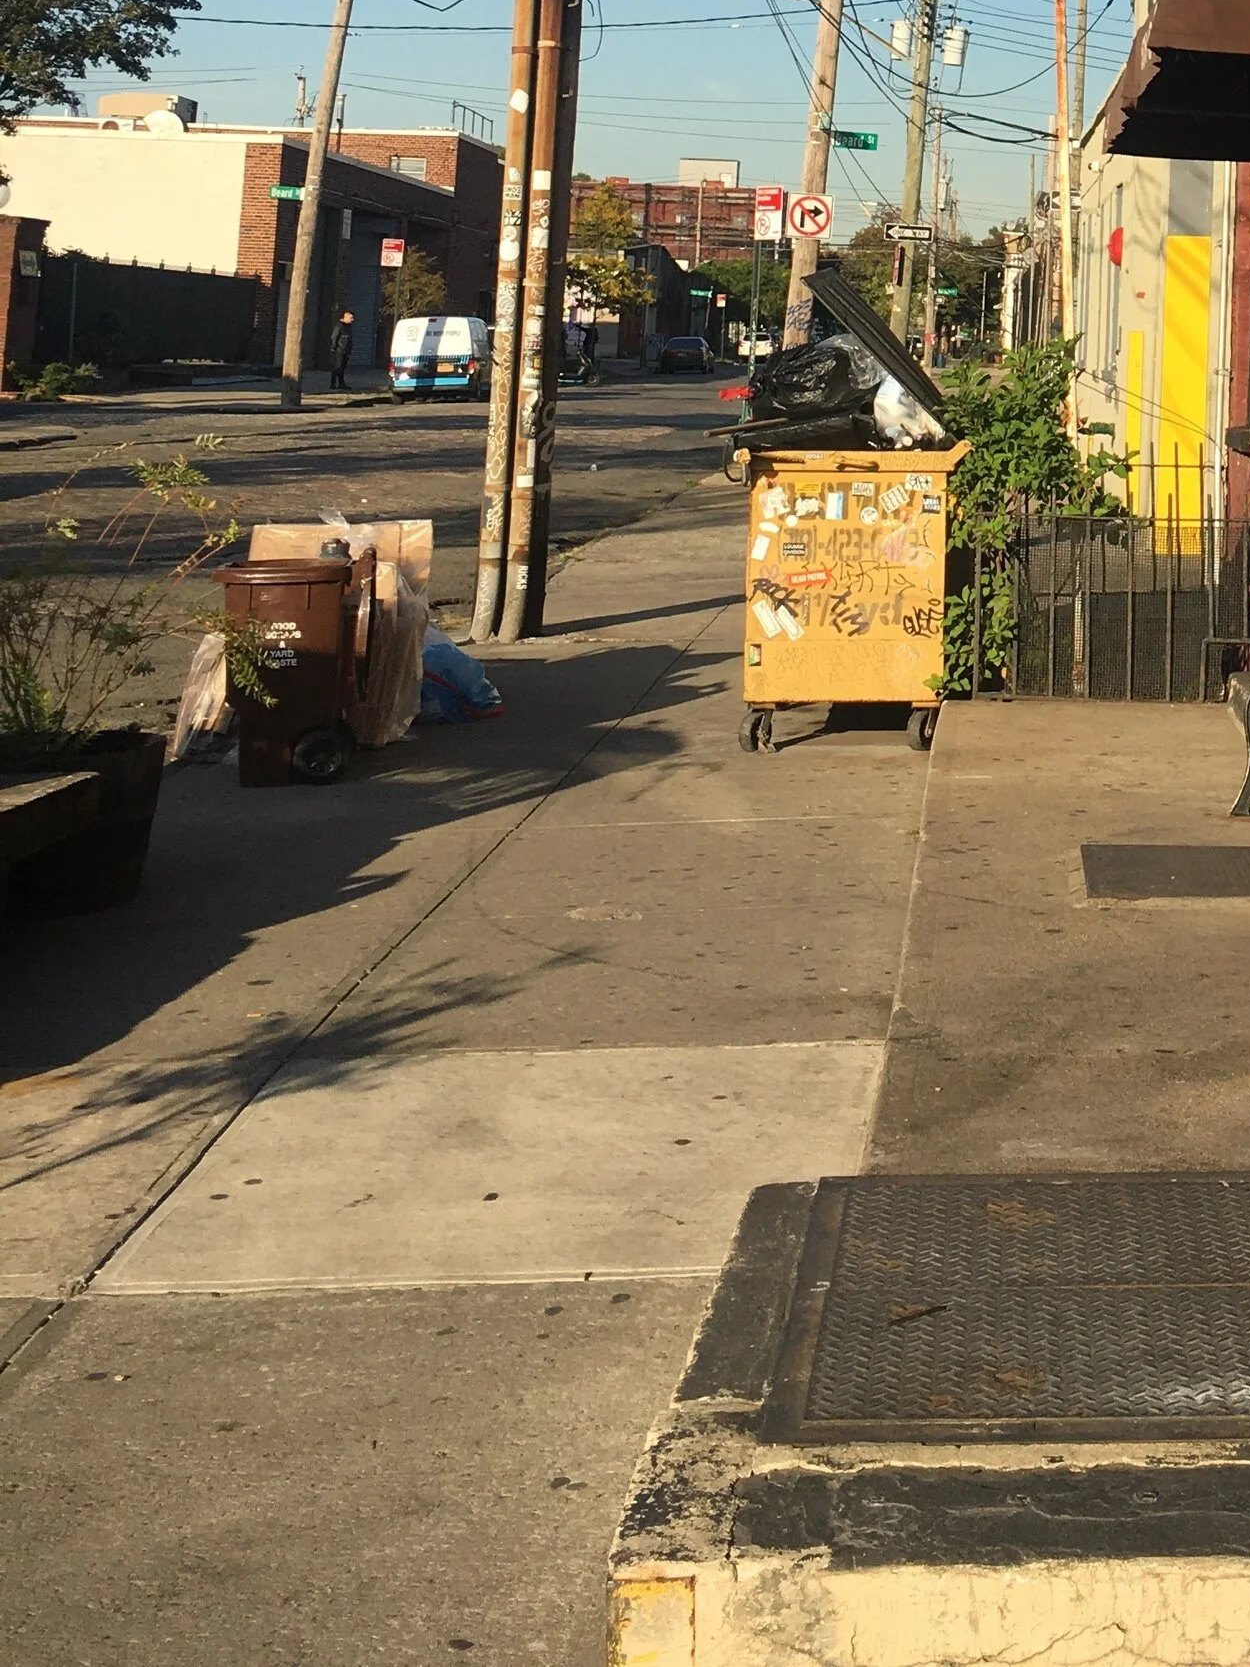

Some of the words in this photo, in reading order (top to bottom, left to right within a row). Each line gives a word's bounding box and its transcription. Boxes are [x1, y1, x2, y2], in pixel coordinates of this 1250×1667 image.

[835, 132, 864, 147] Beard
[868, 135, 875, 144] St
[271, 187, 293, 198] Beard
[516, 565, 528, 590] RICKS
[270, 650, 294, 658] YARD
